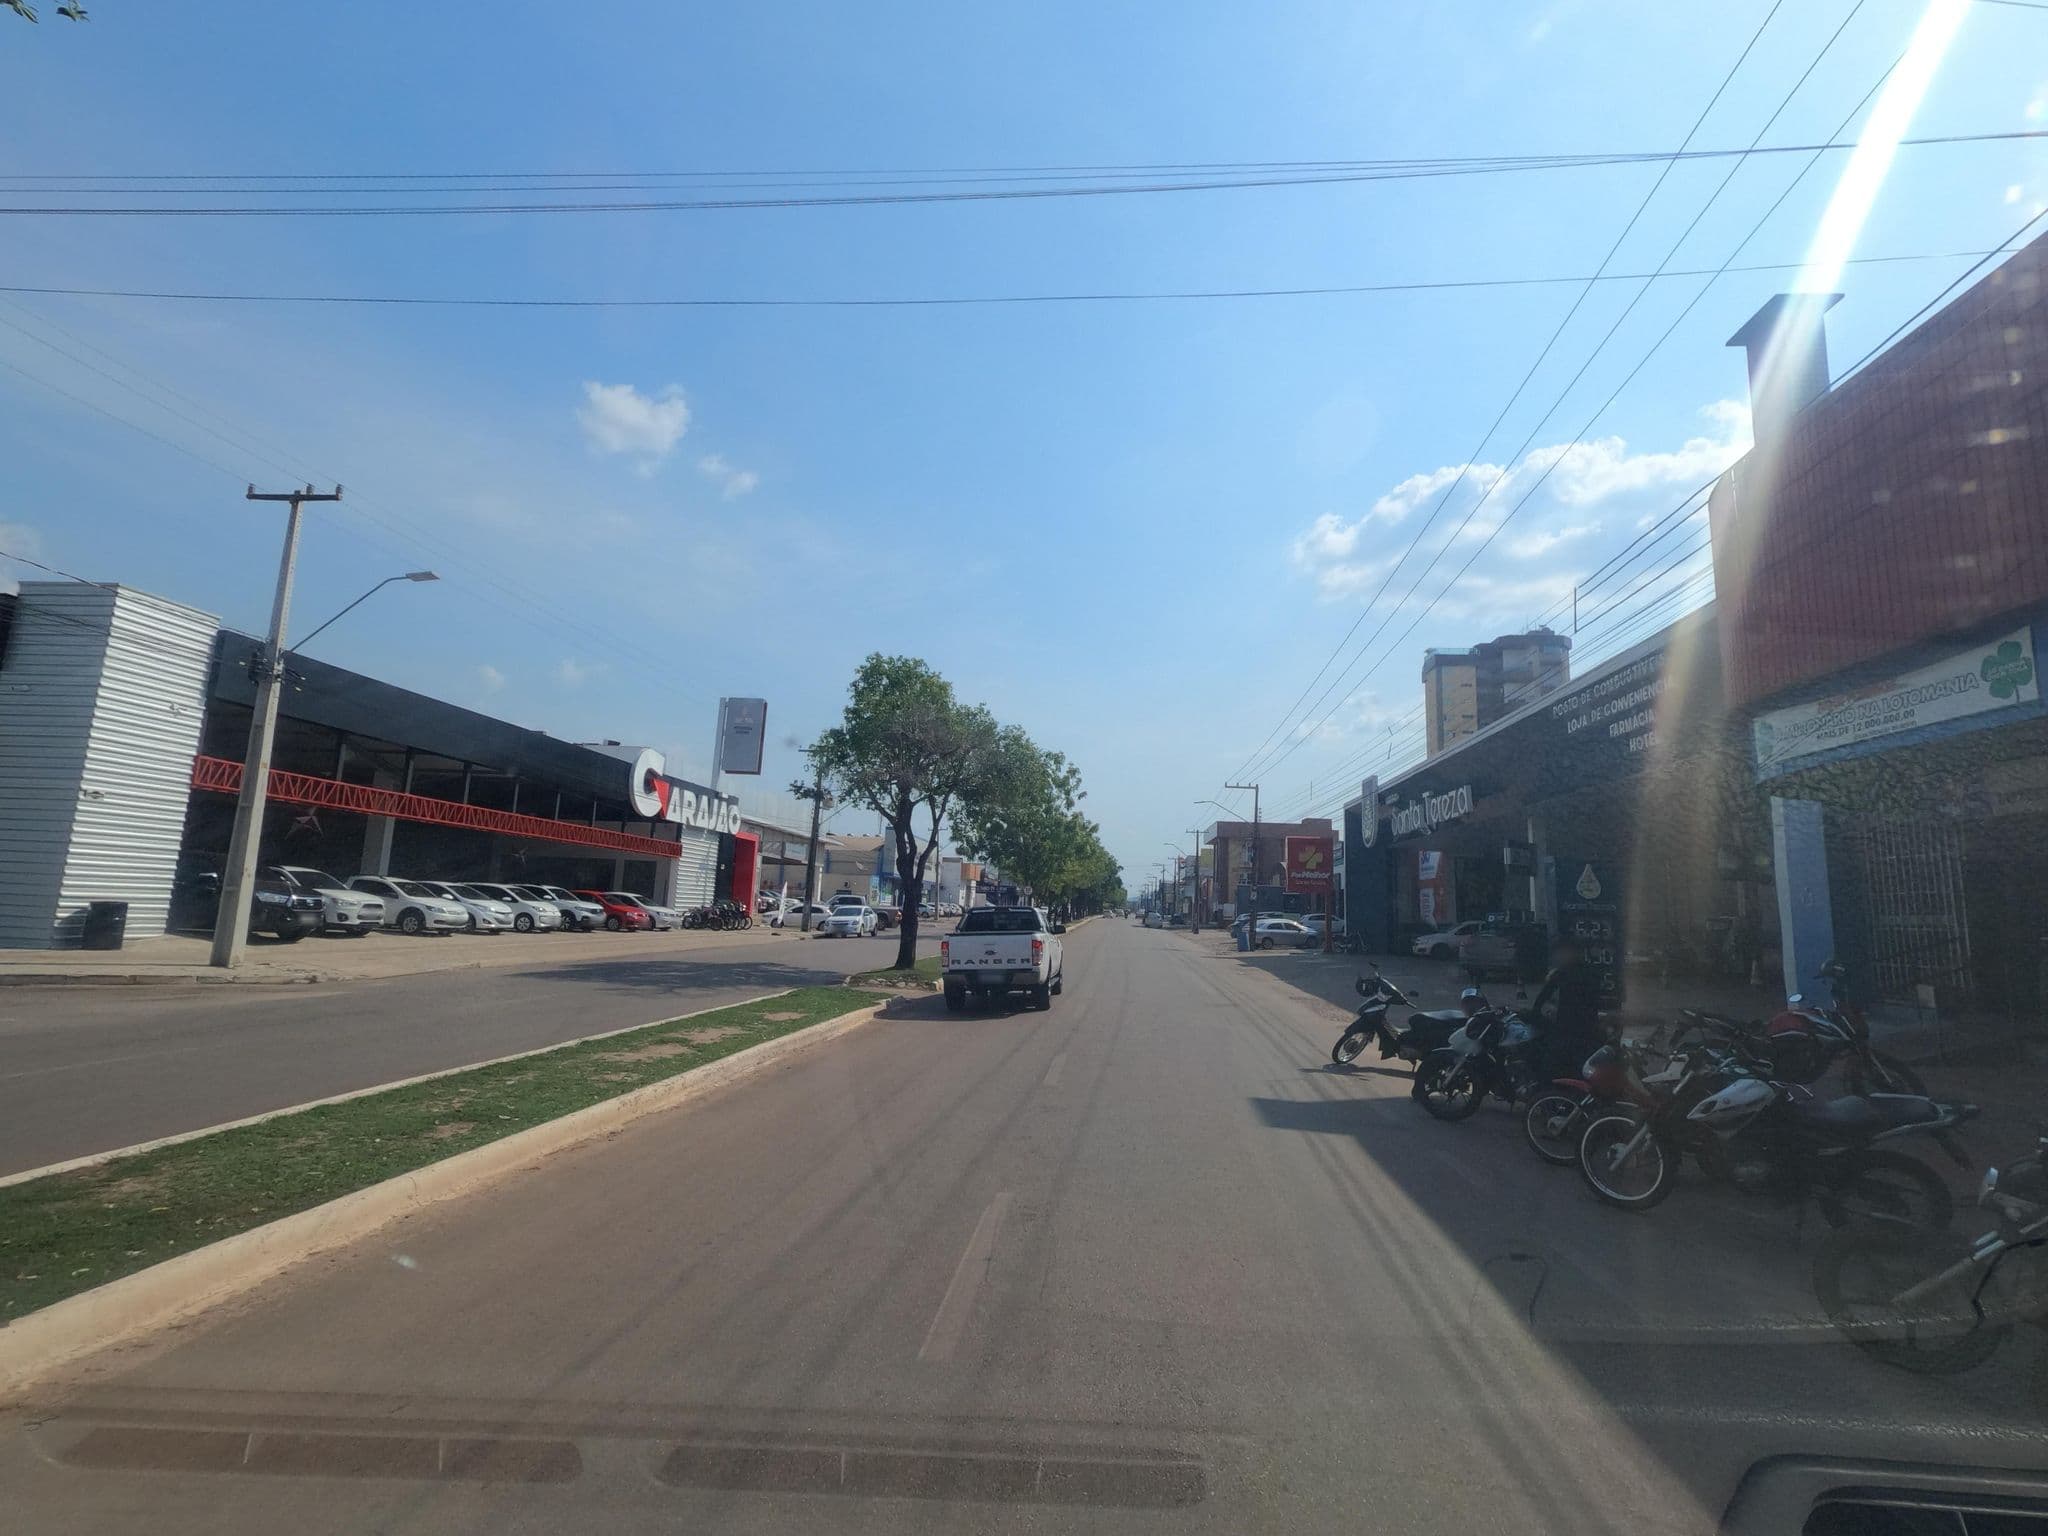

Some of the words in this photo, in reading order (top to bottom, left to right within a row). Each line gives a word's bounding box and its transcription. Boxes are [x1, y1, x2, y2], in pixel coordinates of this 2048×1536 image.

[1552, 696, 1579, 719] POSTO
[1580, 690, 1592, 705] DE
[1857, 700, 1882, 720] NA
[1881, 672, 1980, 714] LOTOMANIA
[1567, 714, 1588, 734] LOJA
[1590, 708, 1602, 722] DE
[1391, 799, 1423, 838] Santa
[1422, 785, 1472, 828] Tereza
[951, 958, 1031, 966] RANGER
